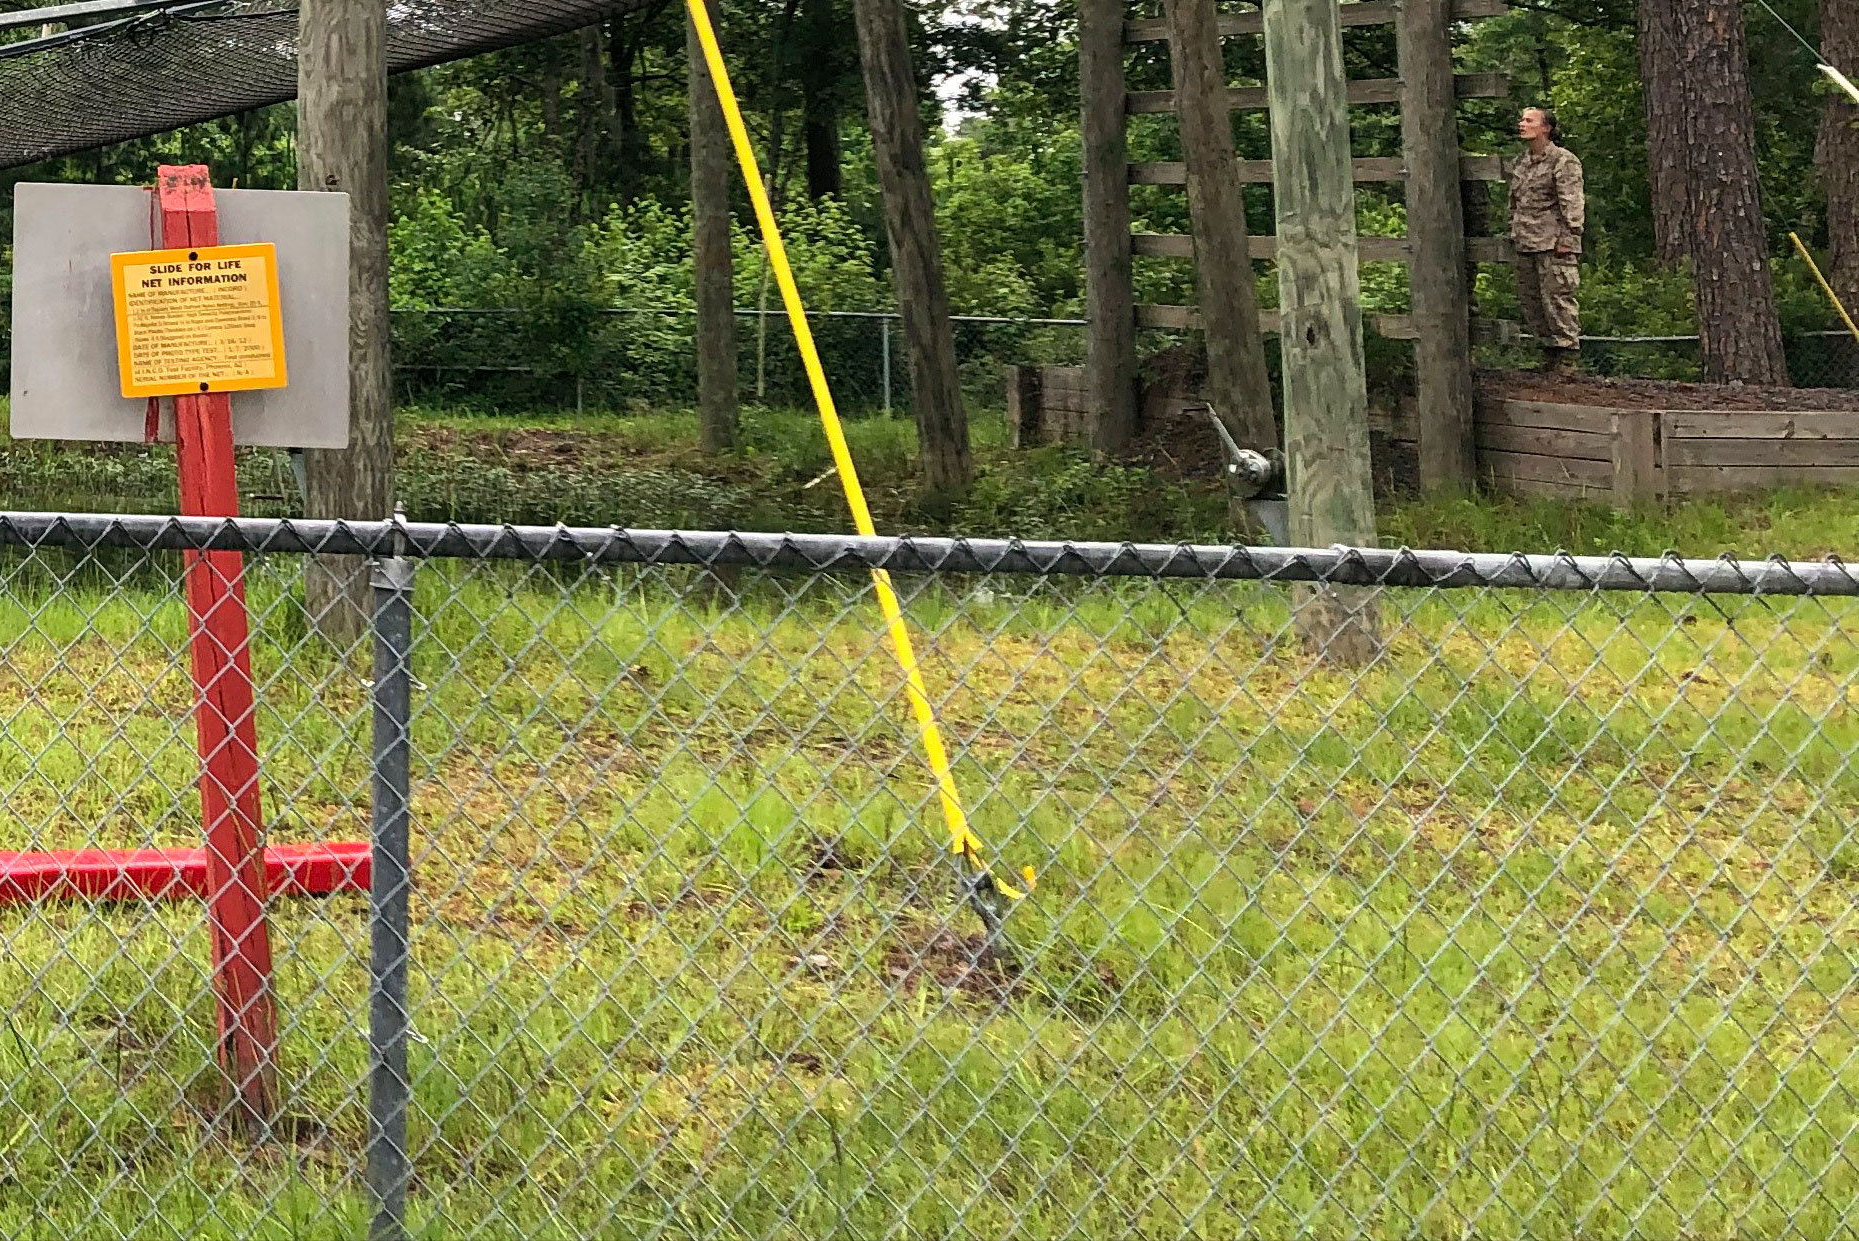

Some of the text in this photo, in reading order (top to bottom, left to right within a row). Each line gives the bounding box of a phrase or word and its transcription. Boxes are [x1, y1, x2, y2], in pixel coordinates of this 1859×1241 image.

[149, 260, 242, 275] SLIDE FOR LIFE
[142, 273, 247, 288] NET INFORMATION
